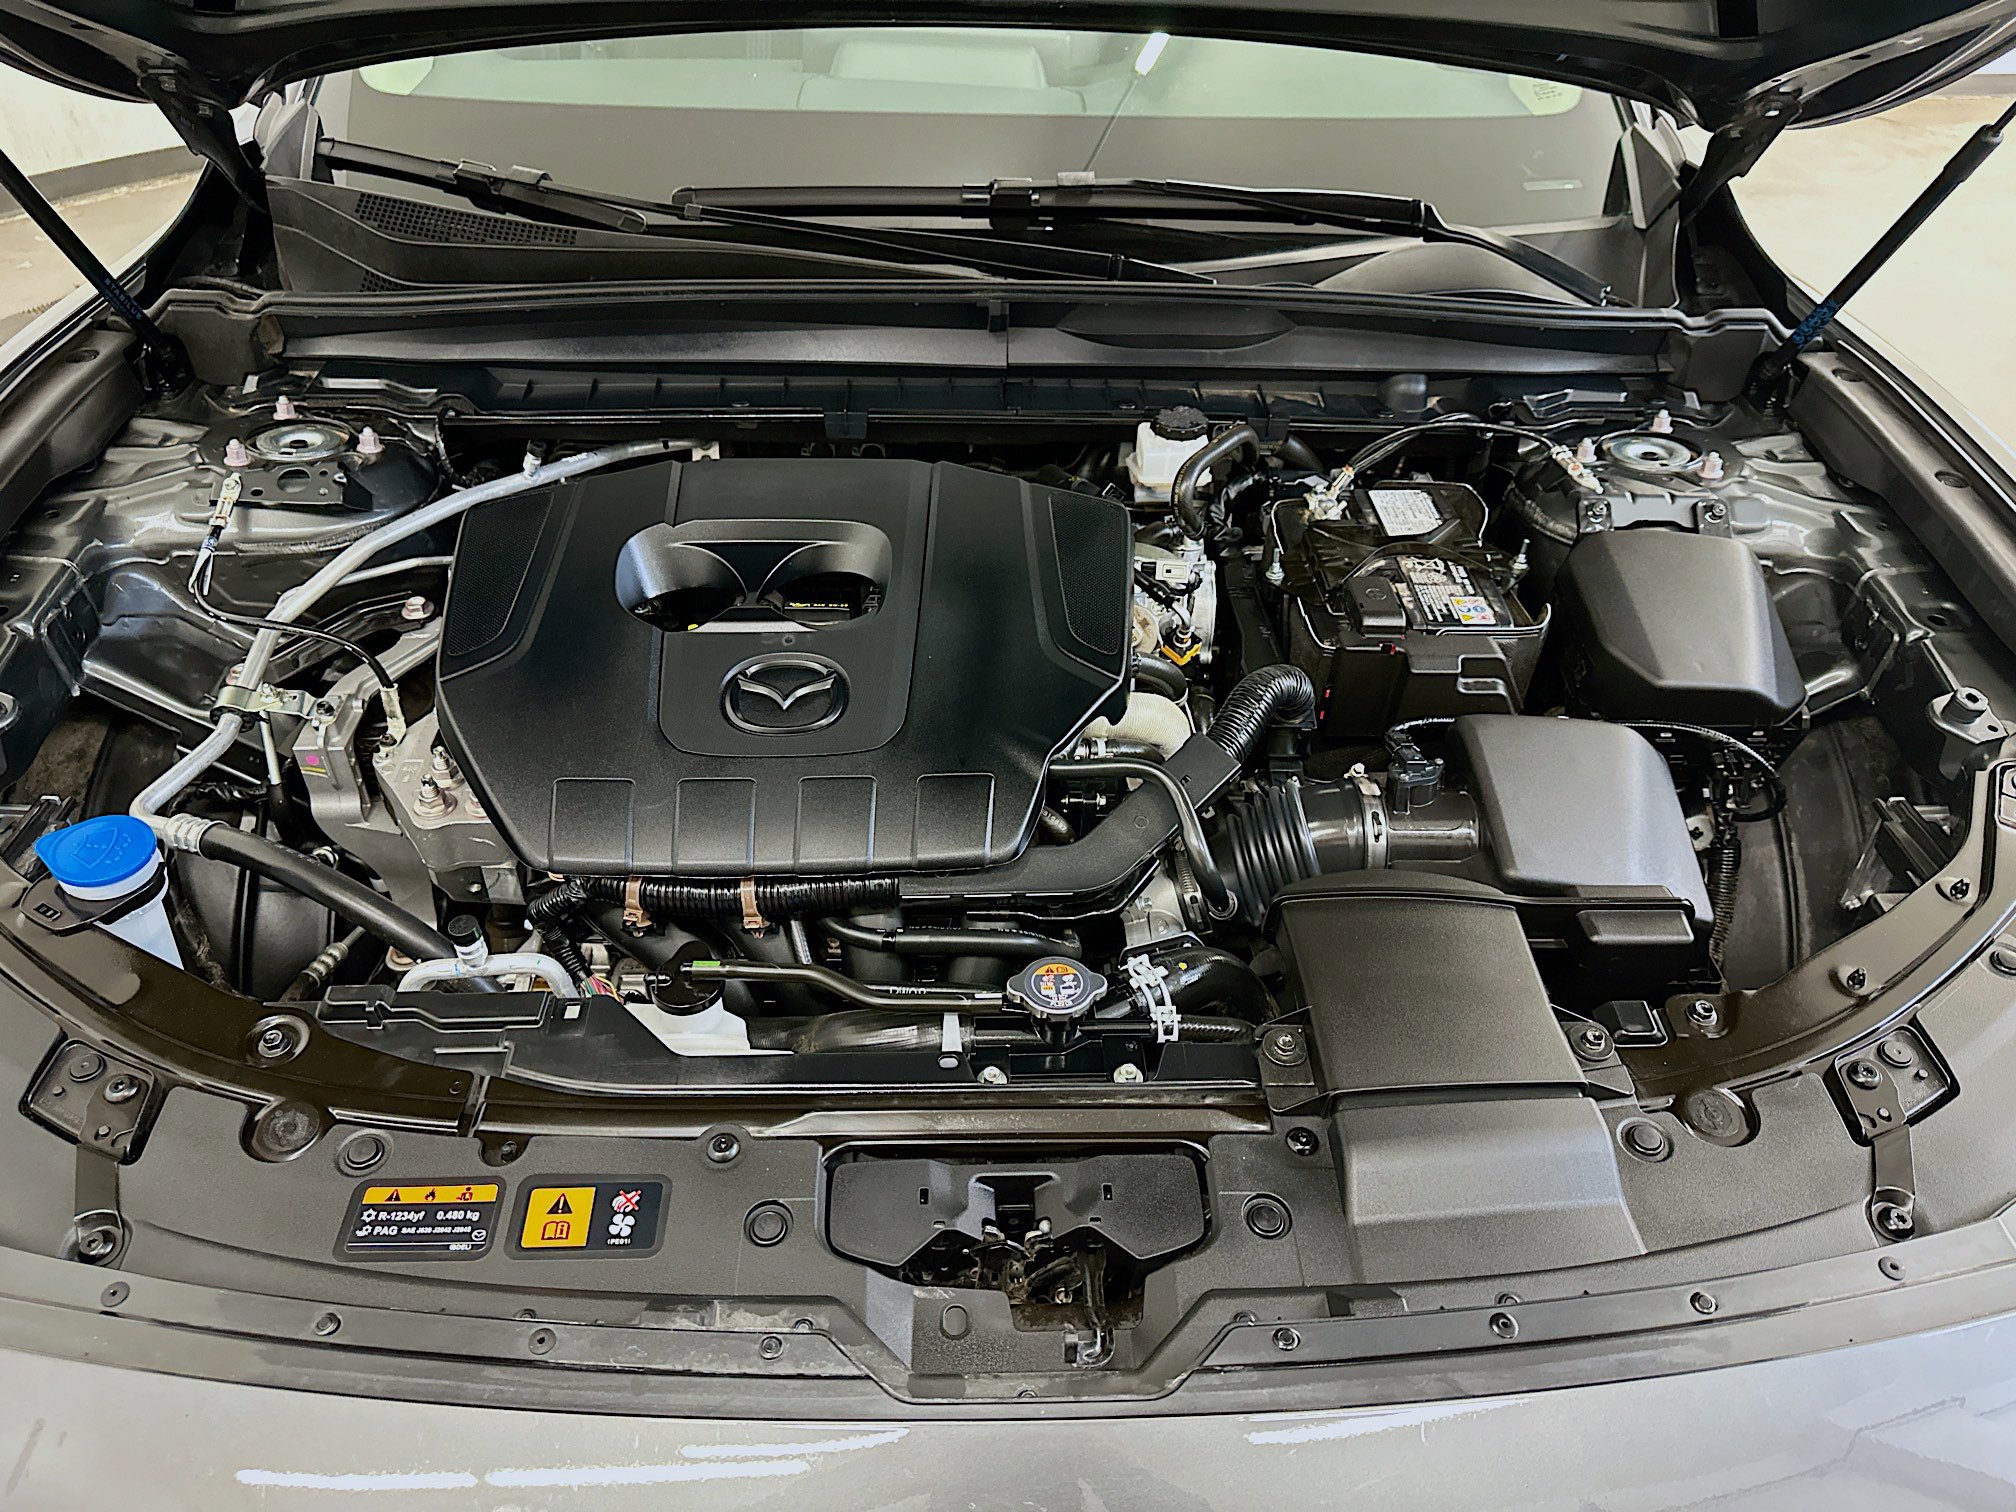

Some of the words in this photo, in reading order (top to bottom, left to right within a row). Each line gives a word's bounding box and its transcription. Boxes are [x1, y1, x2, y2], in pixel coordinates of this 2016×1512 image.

[377, 1210, 426, 1222] R-1234yf
[466, 1209, 480, 1222] kg
[372, 1225, 398, 1236] PAG
